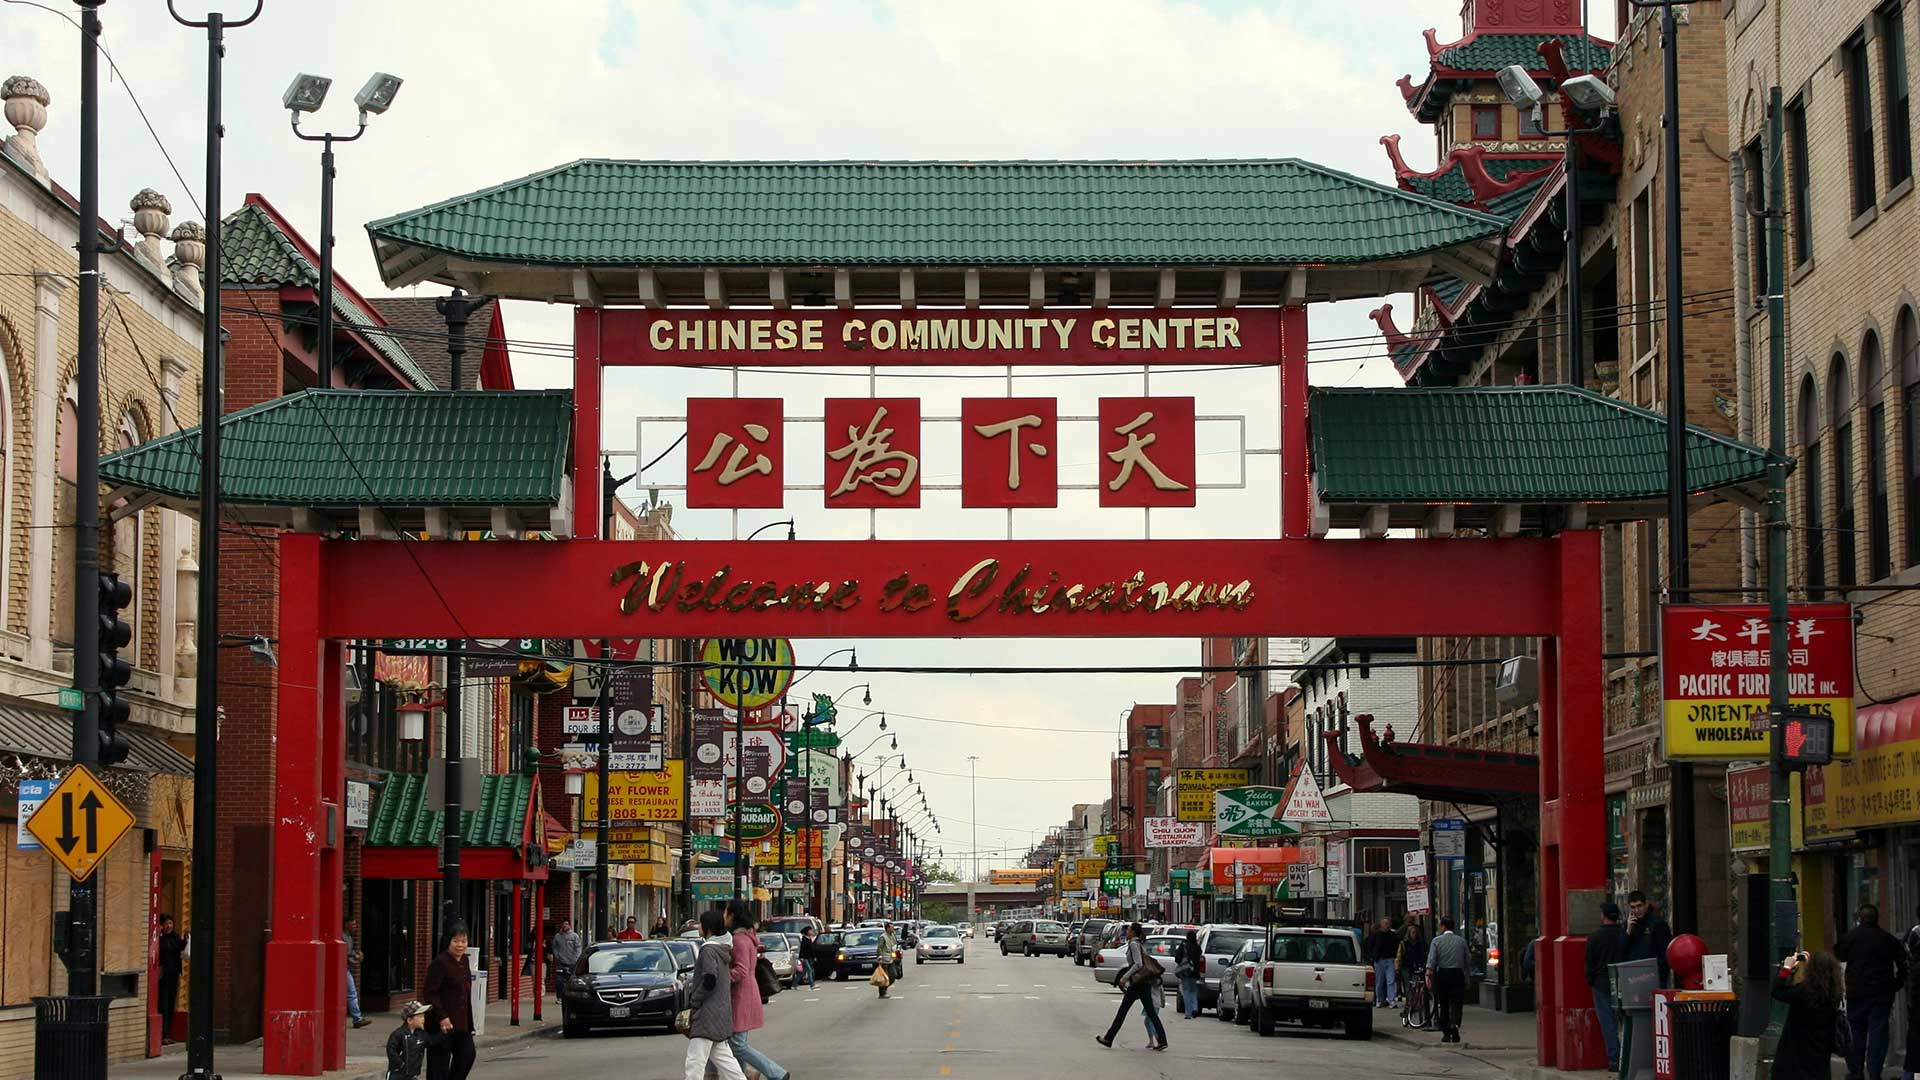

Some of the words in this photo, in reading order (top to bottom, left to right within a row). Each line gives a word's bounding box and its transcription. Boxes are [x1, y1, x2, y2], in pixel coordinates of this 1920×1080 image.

[649, 319, 825, 351] CHINESE
[842, 318, 1077, 351] COMMUNITY
[1091, 317, 1242, 350] CENTER
[692, 423, 773, 487] 公
[973, 414, 1048, 490] 下
[1106, 411, 1190, 491] 天
[610, 560, 863, 614] Welcome
[880, 571, 936, 613] to
[948, 558, 1256, 623] Chinatown
[718, 638, 777, 662] WON
[718, 666, 777, 694] KOW
[1679, 674, 1732, 696] PACIFIC
[1820, 681, 1839, 694] INC.
[567, 724, 589, 733] FOUR
[627, 786, 670, 796] FLOWER
[22, 803, 34, 812] 24
[628, 798, 679, 806] RESTAURANT
[1293, 799, 1303, 808] TAI
[1306, 799, 1320, 808] WAH
[1311, 810, 1327, 818] STORE
[1289, 865, 1306, 873] ONE
[1289, 873, 1307, 881] WAY
[1656, 1058, 1670, 1075] EYE
